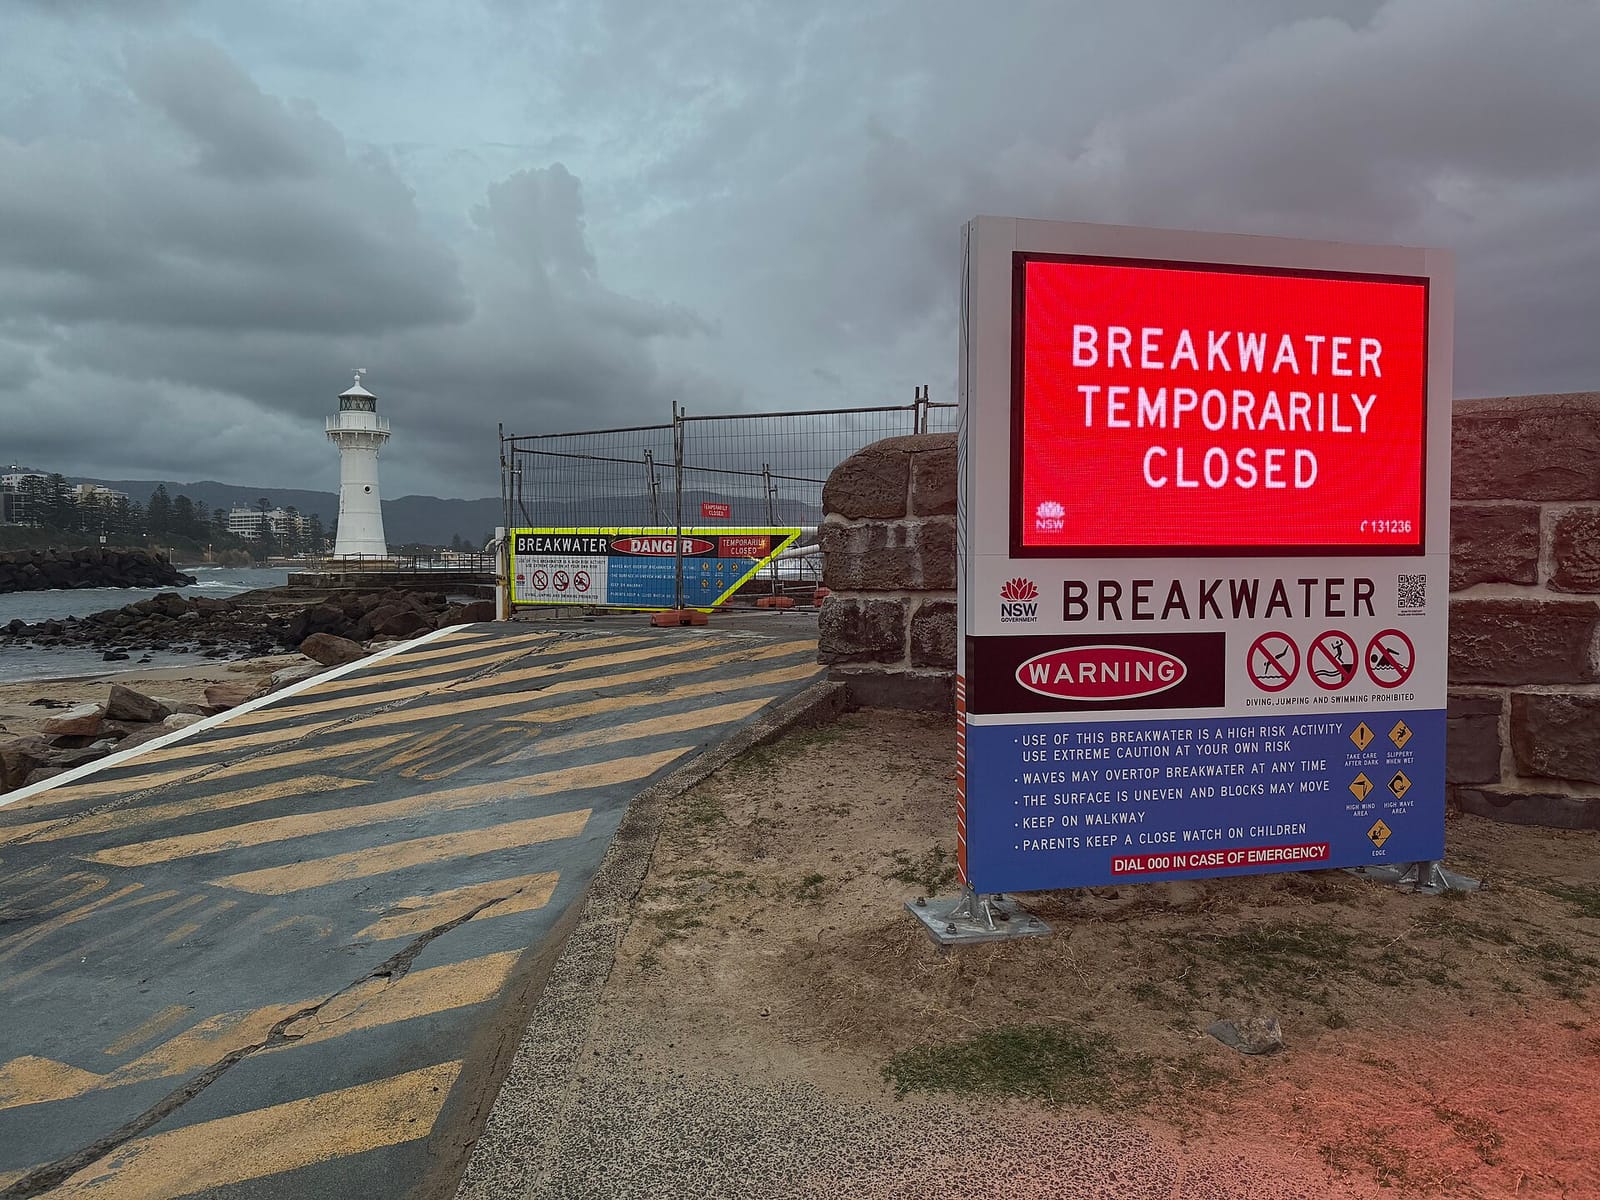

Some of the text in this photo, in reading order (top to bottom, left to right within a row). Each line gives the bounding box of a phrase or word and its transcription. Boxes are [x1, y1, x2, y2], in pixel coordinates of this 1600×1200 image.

[1072, 324, 1382, 378] BREAKWATER
[1077, 385, 1377, 433] TEMPORARILY
[1143, 446, 1318, 489] CLOSED
[1036, 519, 1064, 529] NSW
[1371, 520, 1411, 533] 131236
[518, 538, 607, 552] BREAKWATER
[723, 540, 766, 549] TEMPORARILY
[1001, 603, 1037, 616] NSW
[1063, 578, 1376, 622] BREAKWATER
[1028, 660, 1175, 685] WARNING
[1331, 695, 1368, 703] SWIMMING
[1371, 693, 1415, 702] PROHIBITED
[1022, 723, 1343, 746] USE OF THIS BREAKWATER IS A HIGH RISK ACTIVITY
[1023, 740, 1291, 762] USE EXTREME CAUTION AT YOUR OWN RISK
[1023, 760, 1327, 784] WAVES MAY OVERTOP BREAKWATER AT ANY TIME
[1023, 781, 1329, 806] THE SURFACE IS UNEVEN AND BLOCKS MAY MOVE
[1023, 812, 1145, 829] KEEP ON WALKWAY
[1023, 823, 1306, 850] PARENTS KEEP A CLOSE WATCH ON CHILDREN
[1114, 845, 1326, 872] DIAL 000 IN CASE OF EMERGENCY
